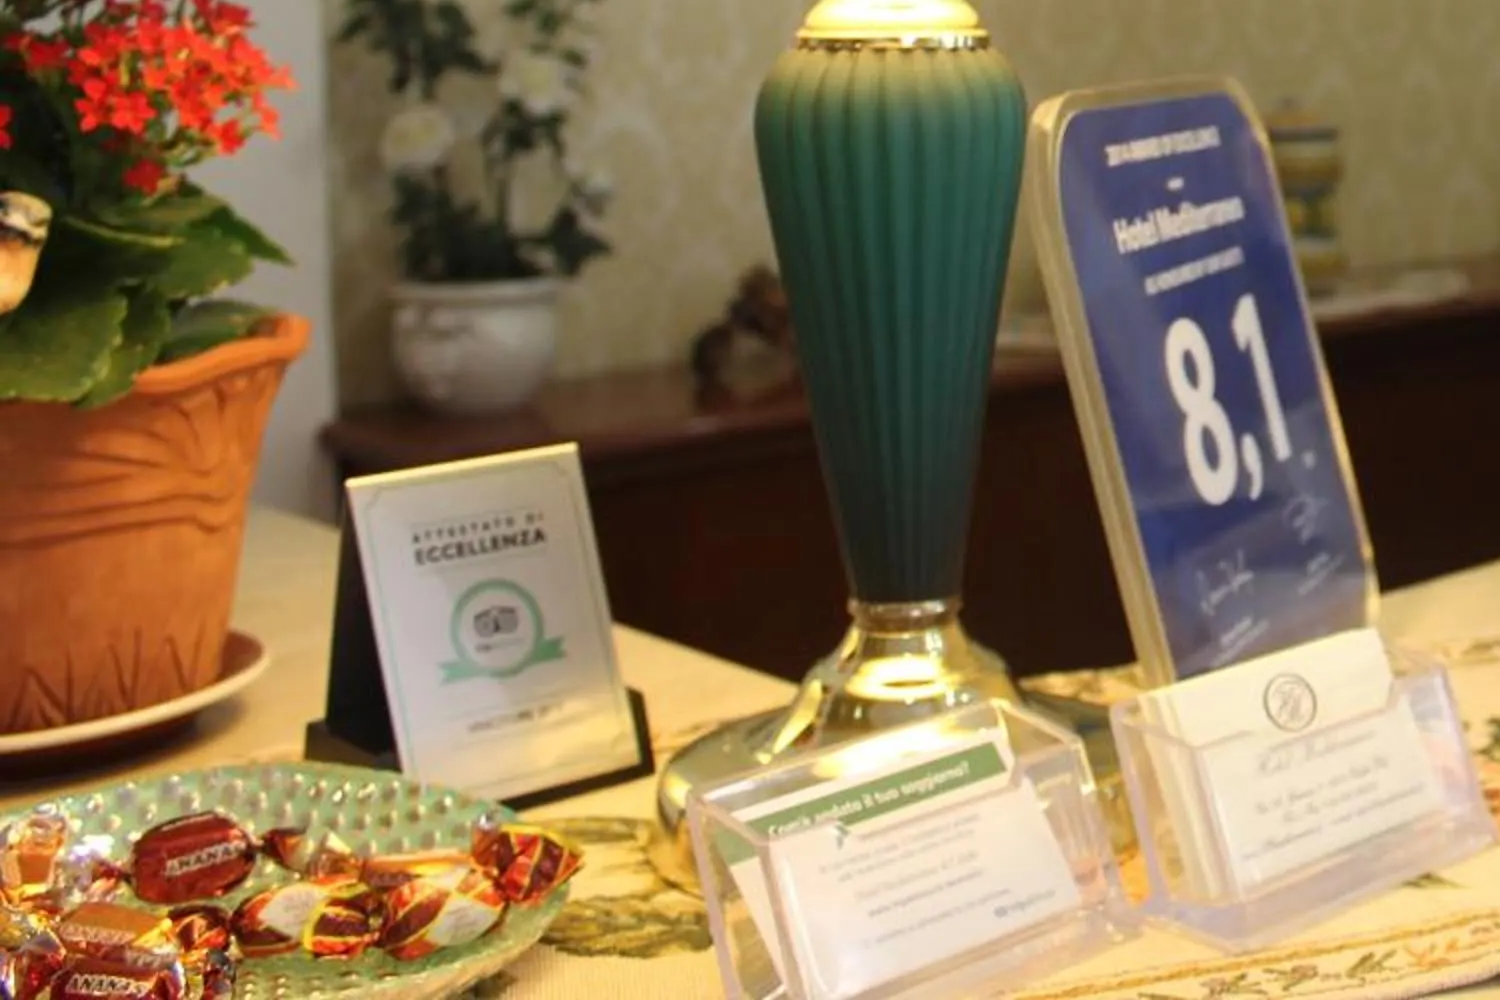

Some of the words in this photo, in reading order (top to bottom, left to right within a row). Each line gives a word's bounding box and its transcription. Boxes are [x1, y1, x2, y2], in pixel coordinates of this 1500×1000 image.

[1164, 292, 1292, 506] 8,1
[412, 515, 515, 545] ATTESTATO
[414, 527, 546, 567] ECCELLENZA
